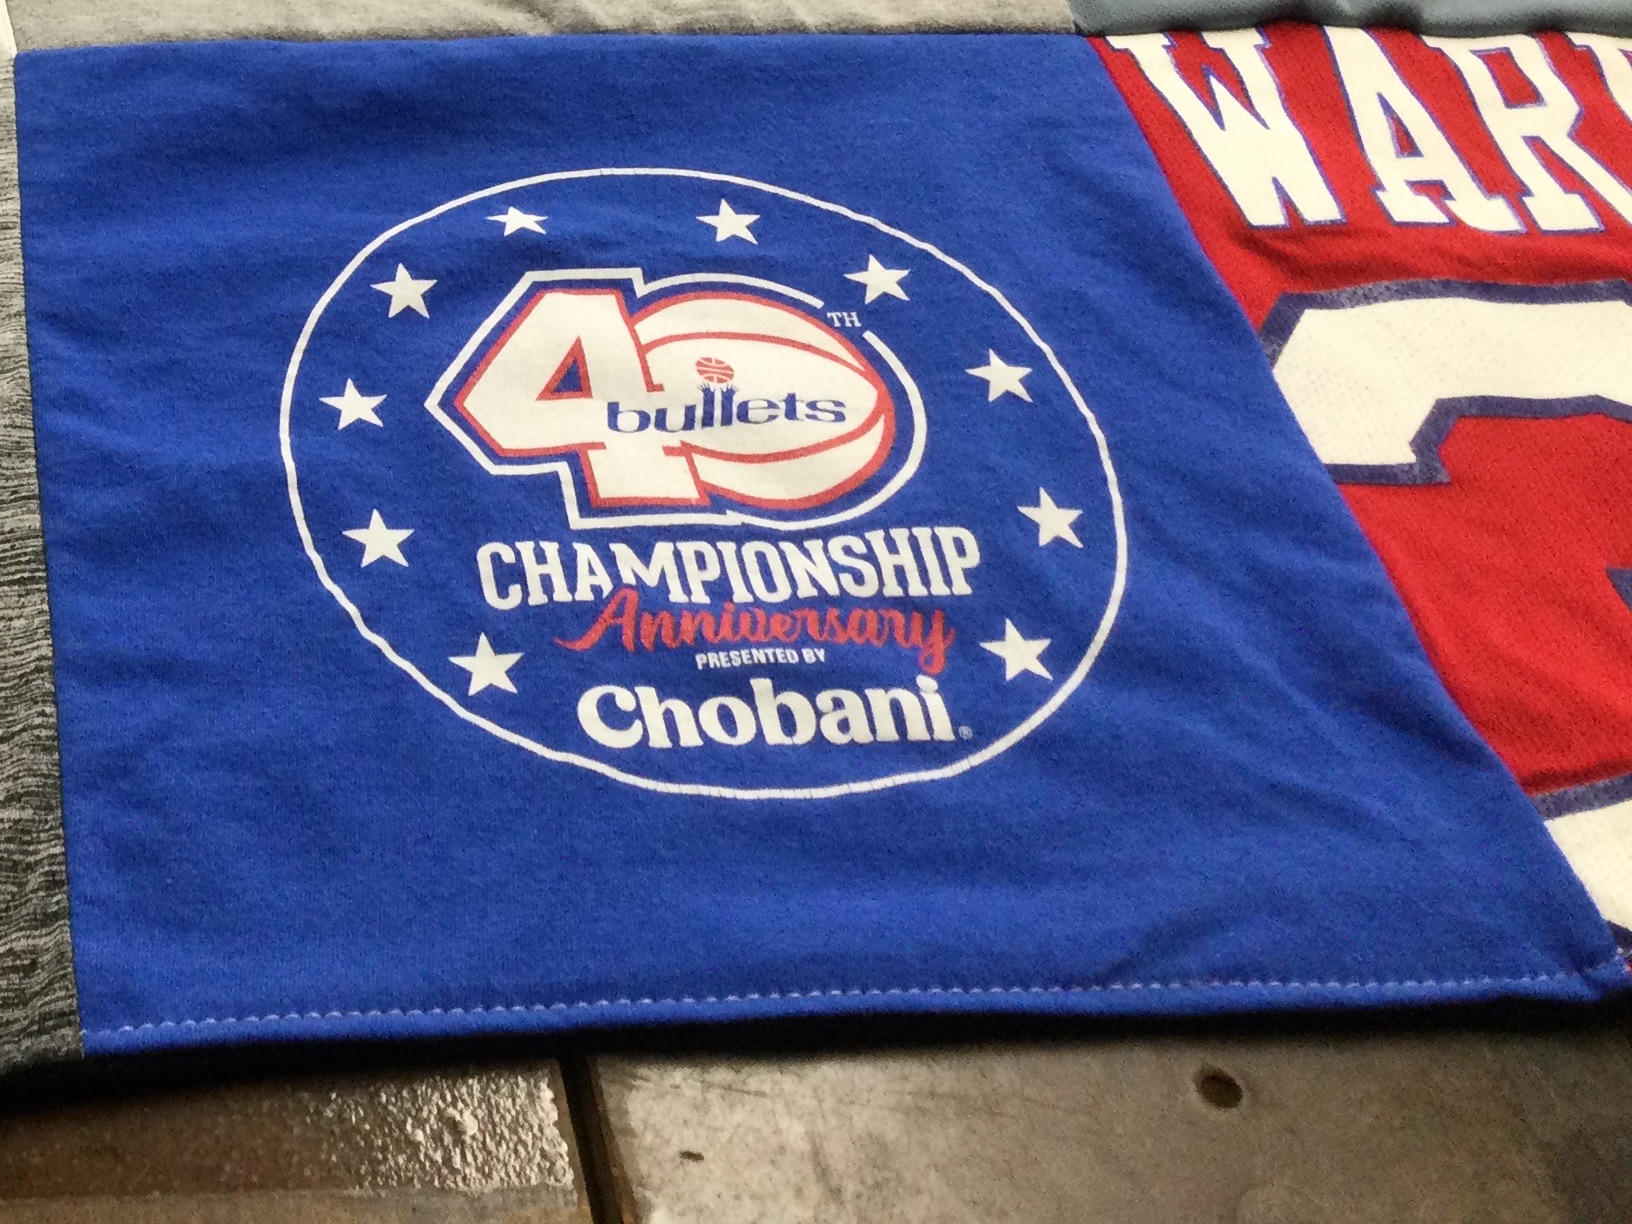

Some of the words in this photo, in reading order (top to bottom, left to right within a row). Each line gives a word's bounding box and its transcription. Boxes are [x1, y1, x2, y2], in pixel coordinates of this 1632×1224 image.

[827, 310, 864, 329] TH
[607, 382, 847, 433] bullets
[476, 526, 981, 611] CHAMPIONSHIP
[553, 588, 957, 675] Anniversary
[695, 649, 800, 671] PRESENTED
[802, 647, 827, 665] BY
[576, 676, 958, 750] Chobani
